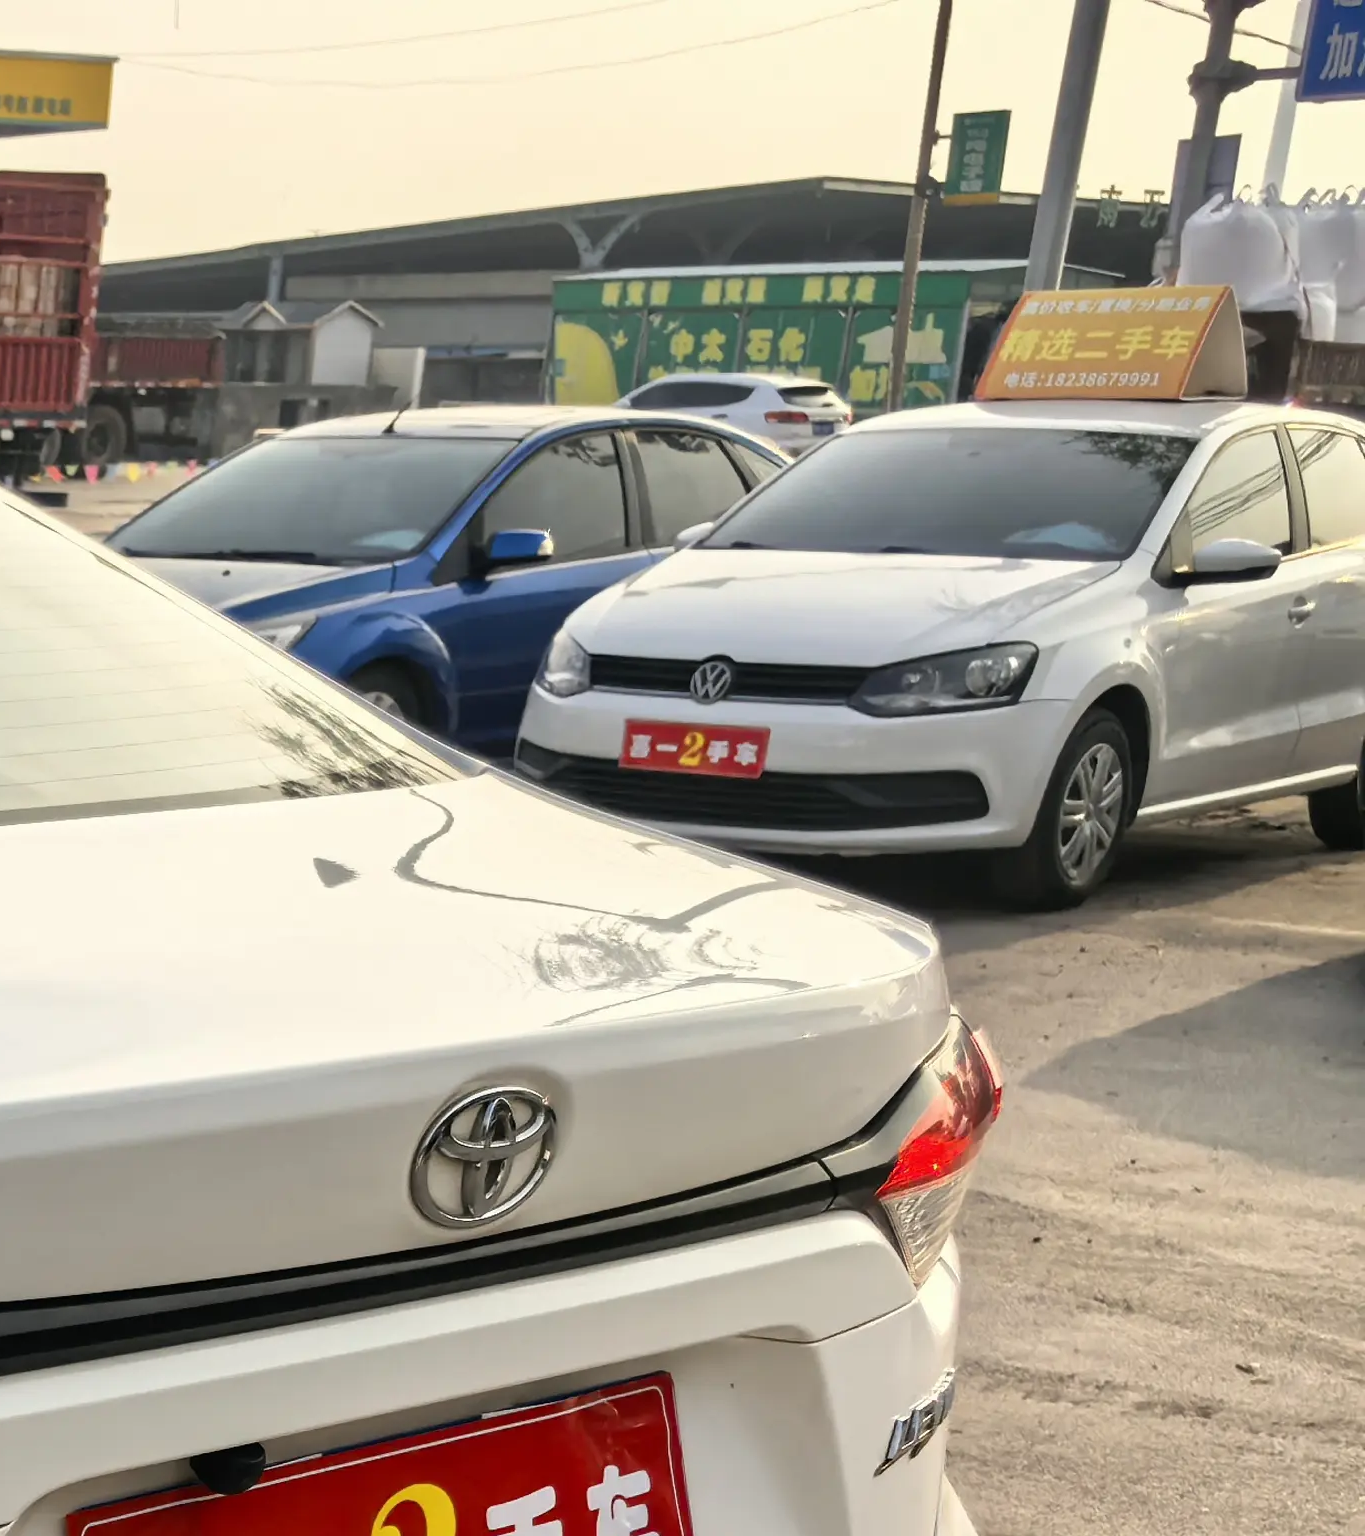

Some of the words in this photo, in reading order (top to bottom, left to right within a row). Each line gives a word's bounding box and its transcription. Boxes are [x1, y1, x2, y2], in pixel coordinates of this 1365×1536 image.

[1319, 22, 1365, 82] 加
[999, 325, 1195, 362] 精选二手车
